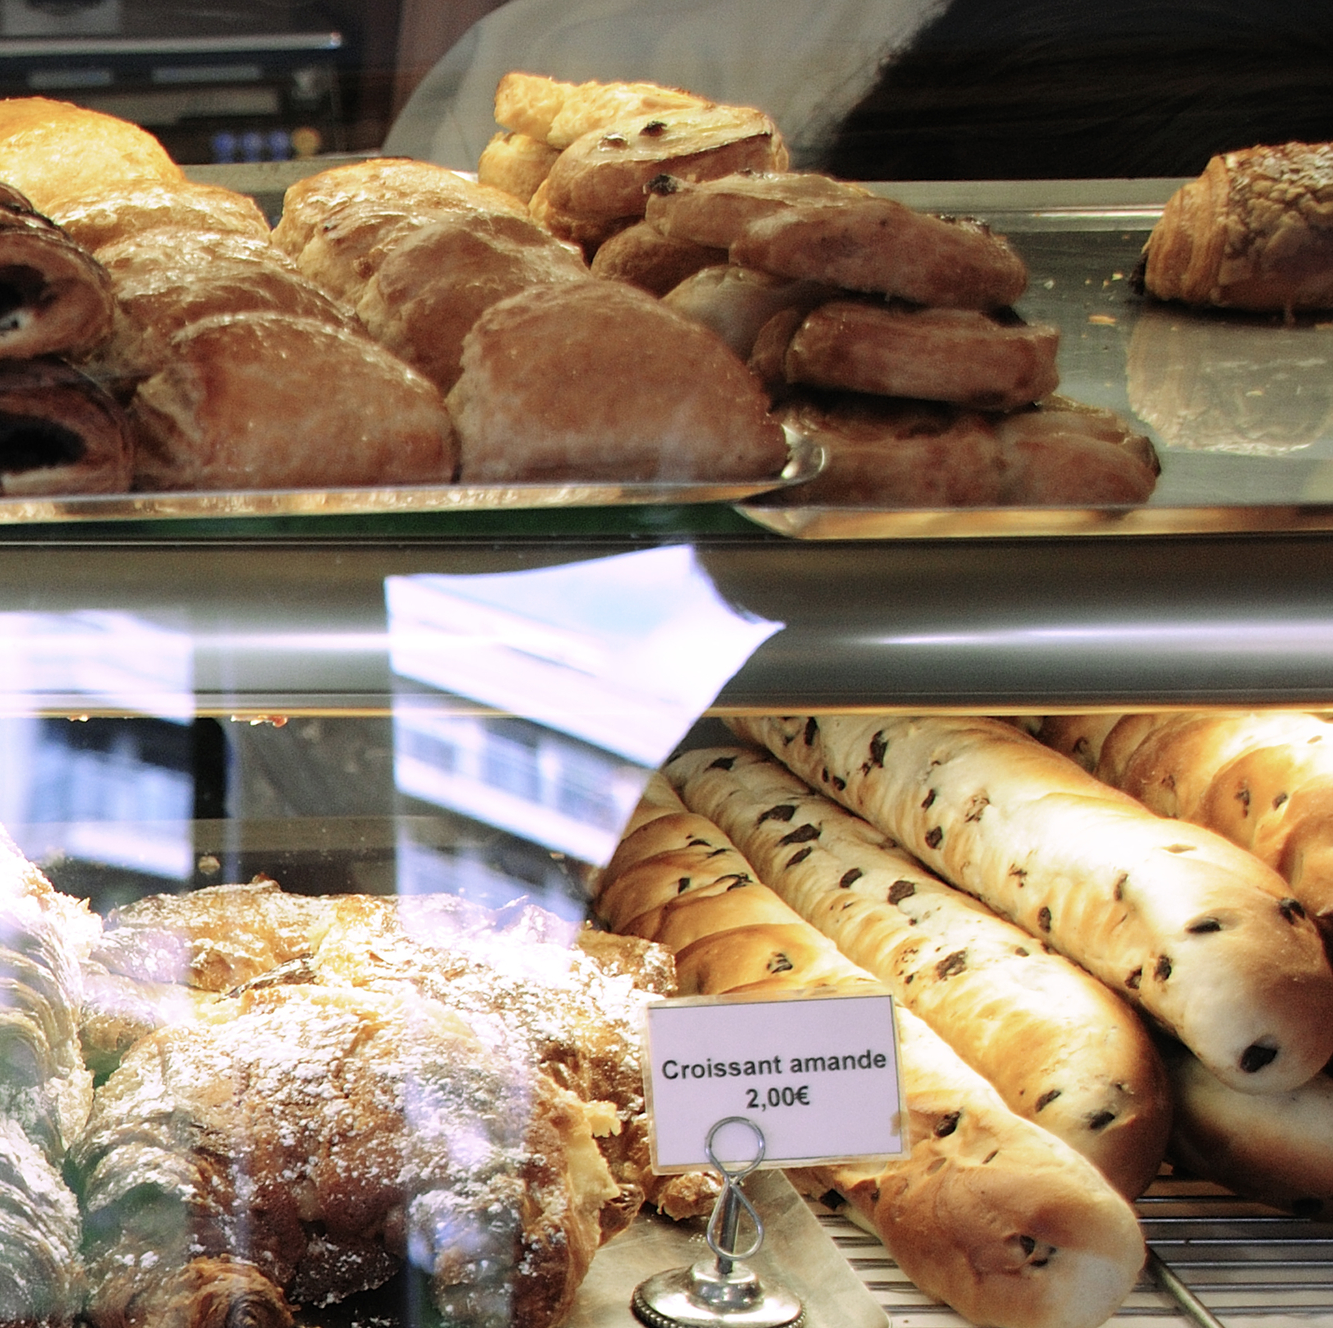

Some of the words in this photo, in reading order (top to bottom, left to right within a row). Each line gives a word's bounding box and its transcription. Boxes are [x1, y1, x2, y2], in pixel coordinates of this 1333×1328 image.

[662, 1055, 783, 1080] Croissant
[789, 1049, 886, 1073] amande
[746, 1085, 810, 1111] 2,00€
